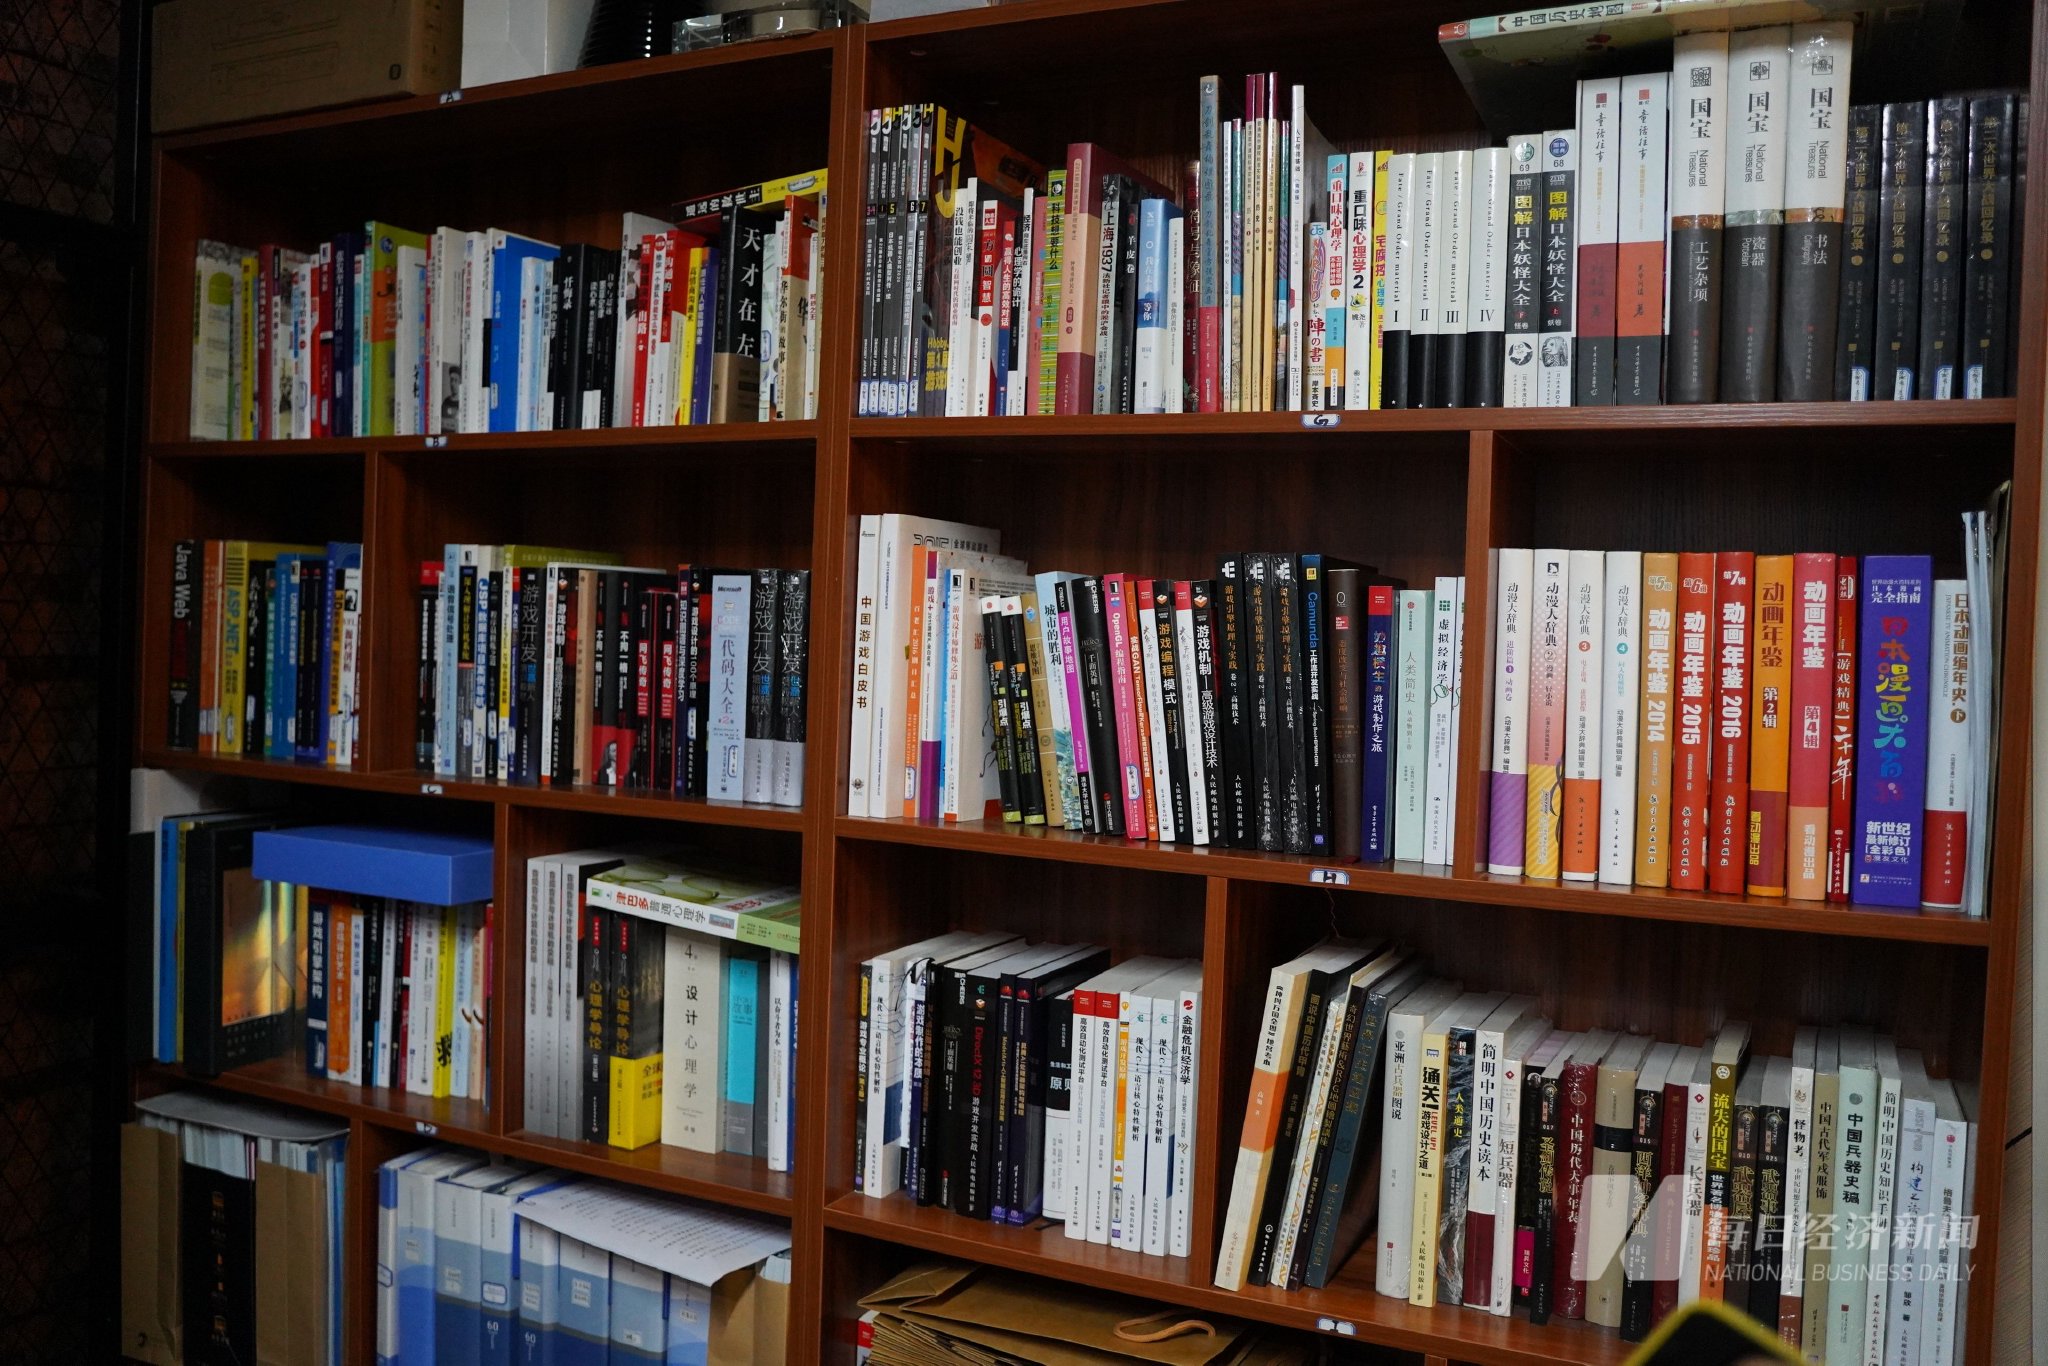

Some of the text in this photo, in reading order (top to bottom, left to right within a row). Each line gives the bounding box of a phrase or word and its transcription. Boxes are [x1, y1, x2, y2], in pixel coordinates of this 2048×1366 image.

[1512, 3, 1623, 28] 中国历史地图
[1689, 97, 1712, 140] 国宝
[1747, 91, 1770, 134] 国宝
[1809, 86, 1833, 130] 国宝
[1553, 158, 1565, 168] 68
[1688, 149, 1698, 188] Treasures
[1698, 149, 1709, 188] National
[1744, 144, 1755, 183] Treasures
[1756, 143, 1767, 183] National
[1807, 140, 1819, 180] Treasures
[1818, 140, 1829, 179] National
[953, 206, 964, 266] 没钱也能创业
[1049, 202, 1061, 270] 科技想要什么
[1101, 211, 1115, 272] 上海1937
[1330, 180, 1344, 251] 重口味心理学
[1352, 189, 1368, 289] 重口味心理学2
[1125, 235, 1136, 274] 羊皮卷
[1451, 233, 1459, 261] Order
[1512, 194, 1534, 306] 图解日本妖怪大全
[1546, 190, 1568, 302] 图解日本妖怪大全
[1694, 241, 1709, 302] 工艺杂项
[1750, 236, 1767, 266] 瓷器
[1813, 234, 1828, 265] 书法
[737, 227, 761, 357] 天才在左
[1000, 247, 1014, 328] 赢得人生的高效对话
[1422, 264, 1430, 301] material
[1449, 264, 1457, 303] material
[1480, 309, 1495, 322] IV
[173, 544, 190, 619] Java Web
[478, 577, 489, 612] JSP
[1089, 585, 1100, 614] CHEERS
[1683, 577, 1708, 594] 第6辑
[1722, 570, 1747, 586] 第7辑
[1871, 592, 1922, 604] 完全指南
[521, 584, 538, 663] 游戏开发
[753, 588, 774, 674] 游戏开发
[783, 589, 804, 675] 游戏开发
[1044, 603, 1062, 666] 城市的胜利
[1113, 611, 1123, 648] OpenGL
[1224, 584, 1238, 670] 游戏引擎原理与实践
[1253, 584, 1265, 673] 游戏引擎原理与实践
[1279, 586, 1292, 673] 游戏引擎原理与实践
[1307, 591, 1320, 649] Camunda
[1505, 581, 1519, 634] 动漫大辞典
[1544, 581, 1560, 647] 动漫大辞典
[1578, 583, 1591, 636] 动漫大辞典
[1616, 584, 1630, 638] 动漫大辞典
[1761, 582, 1785, 668] 动画年鉴
[1802, 580, 1827, 669] 动画年鉴
[857, 595, 872, 709] 中国游戏白皮书
[1061, 616, 1075, 674] 用户故事地图
[1088, 654, 1098, 686] 千面英雄
[1158, 623, 1177, 705] 游戏编程模式
[1436, 618, 1450, 685] 虚拟经济学
[1647, 608, 1671, 694] 动画年鉴
[1681, 611, 1706, 698] 动画年鉴
[1721, 601, 1746, 689] 动画年鉴
[1951, 593, 1970, 703] 日本动画编年史
[720, 638, 736, 715] 代码大全
[1309, 649, 1319, 701] 工作流开发实战
[1371, 630, 1388, 753] 妙趣横生的游戏制作之旅
[1404, 650, 1416, 704] 人类简史
[997, 698, 1009, 727] 引爆点
[1019, 701, 1032, 729] 引爆点
[1647, 700, 1667, 742] 2014
[1681, 703, 1702, 745] 2015
[1721, 695, 1743, 739] 2016
[1762, 687, 1778, 729] 第2辑
[1804, 705, 1821, 749] 第4辑
[1831, 725, 1853, 801] 二十年
[1175, 782, 1185, 825] 人民邮电出版社
[1209, 773, 1219, 827] 人民邮电出版社
[1234, 773, 1243, 827] 人民邮电出版社
[1865, 820, 1911, 836] 新世纪
[1865, 835, 1911, 846] 最新修订
[1873, 856, 1910, 864] 漫友文化
[615, 891, 707, 924] 津巴多普通心理学
[684, 984, 699, 1099] 设计心理学
[1076, 1017, 1089, 1084] 高效自动化测试平台
[1099, 1020, 1111, 1088] 高效自动化测试平台
[1179, 1014, 1193, 1085] 金融危机经济学
[969, 1026, 984, 1152] DirectX 游戏开发实战
[1131, 1036, 1144, 1142] 现代C++语言核心特性解析
[1154, 1038, 1168, 1145] 现代C++语言核心特性解析
[1391, 1040, 1406, 1120] 亚洲古兵器图说
[1430, 1111, 1438, 1135] LEVEL
[1453, 1092, 1464, 1138] 人类通史
[1476, 1043, 1496, 1182] 简明中国历史读本
[1710, 1093, 1730, 1170] 流失的国宝
[1792, 1118, 1807, 1158] 怪物考
[1418, 1110, 1431, 1170] 游戏设计之道
[1498, 1138, 1514, 1189] 短兵器
[1765, 1154, 1779, 1162] 025
[1815, 1101, 1832, 1200] 中国古代军戎服饰
[1842, 1113, 1864, 1206] 中国兵器史稿
[1875, 1091, 1897, 1231] 简明中国历史知识手册
[1566, 1113, 1585, 1224] 中国历代大事年表
[1685, 1164, 1703, 1217] 长兵器
[1906, 1161, 1925, 1216] 构建之法
[1416, 1240, 1426, 1291] 人民邮电出版社
